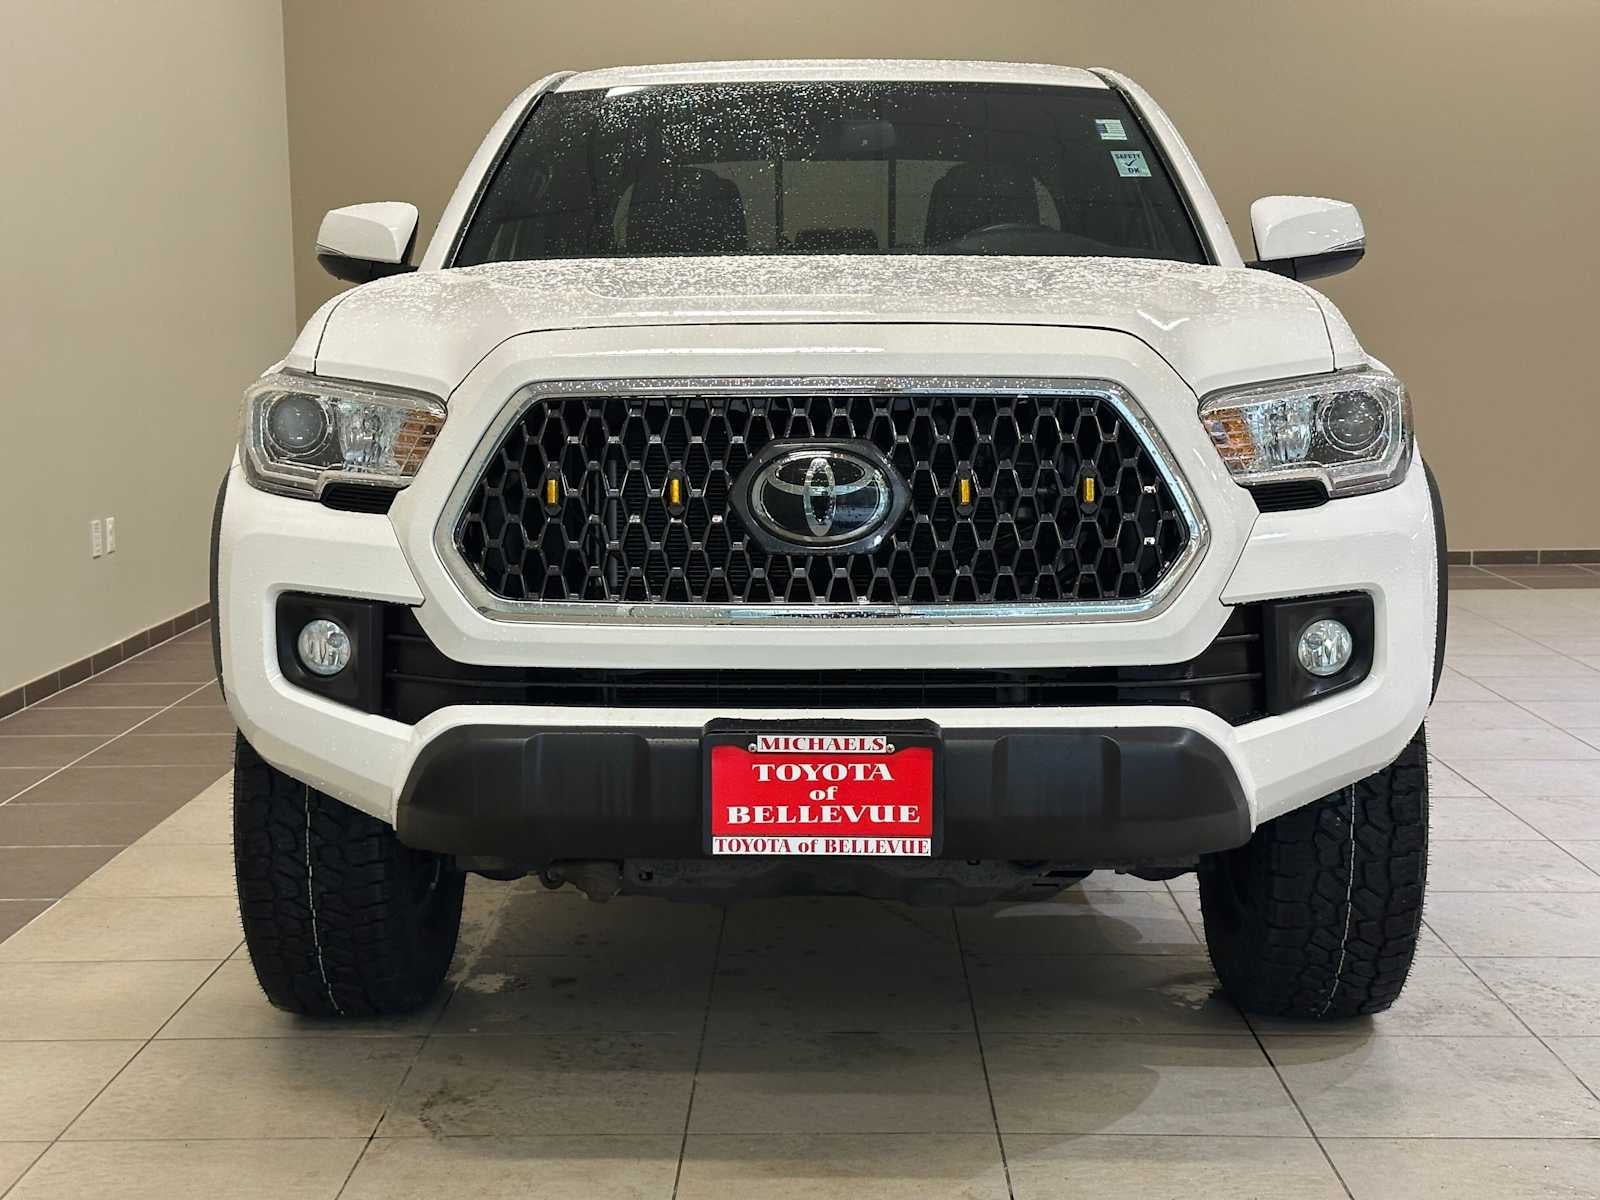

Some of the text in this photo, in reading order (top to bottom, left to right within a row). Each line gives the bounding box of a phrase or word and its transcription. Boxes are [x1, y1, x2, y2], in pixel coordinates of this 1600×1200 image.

[761, 737, 884, 751] MICHAELS
[752, 763, 894, 782] TOYOTA
[809, 786, 838, 801] of
[727, 805, 920, 824] BELLEVUE
[715, 838, 929, 854] TOYOTA of BELLEVUE
